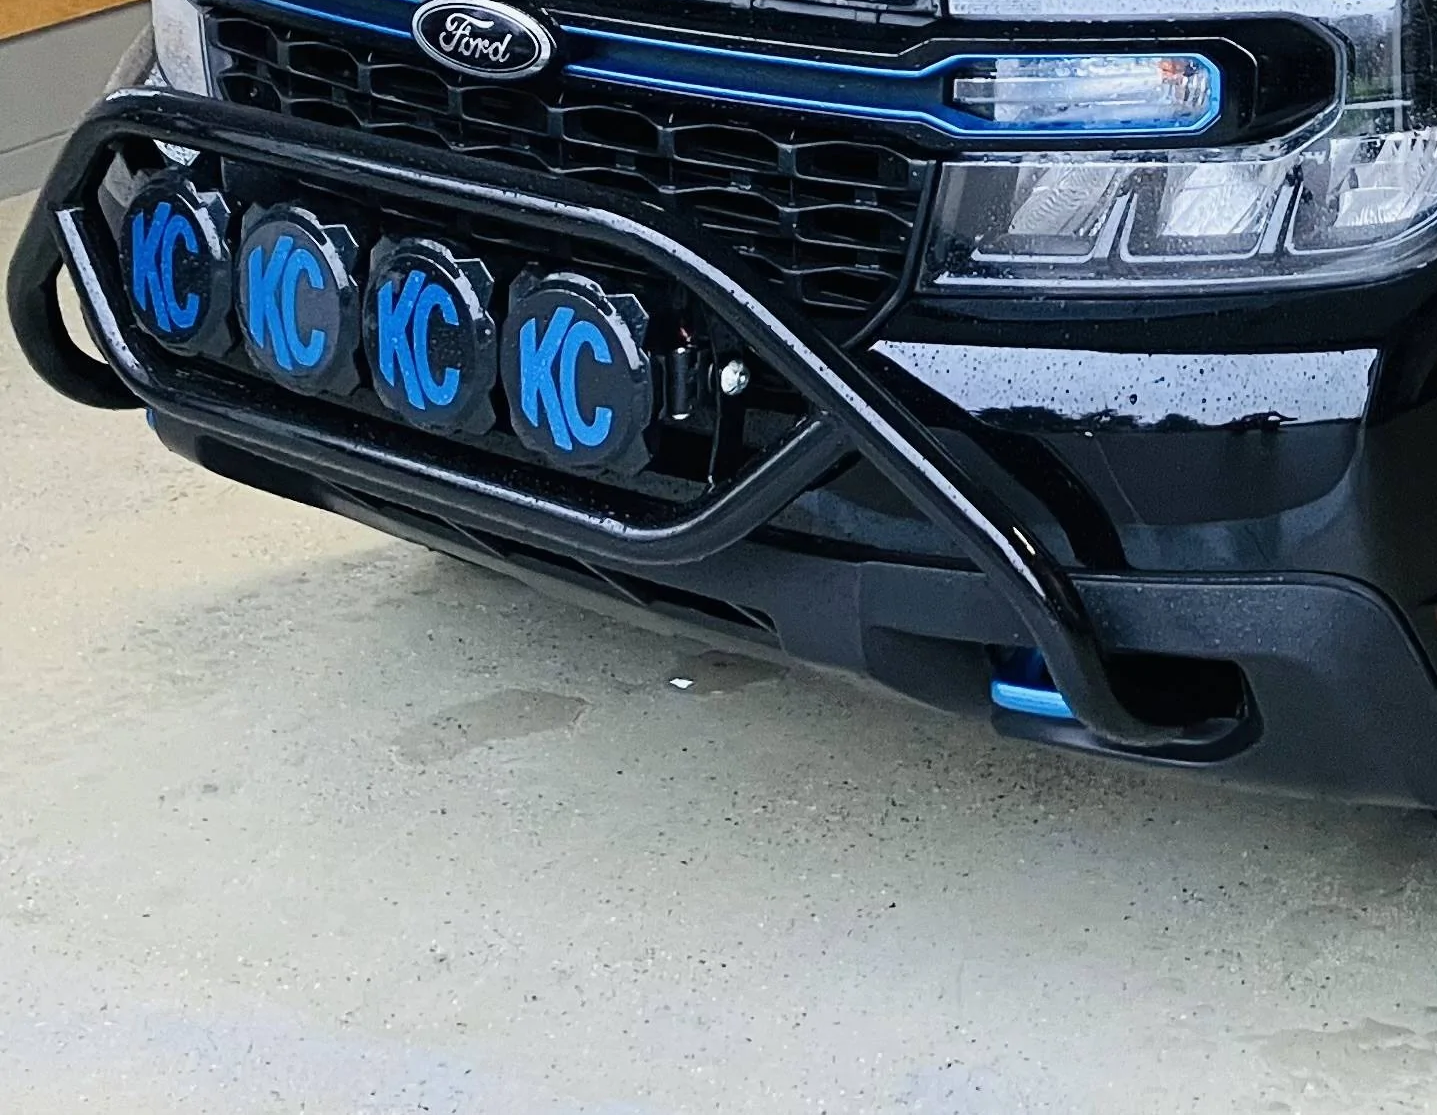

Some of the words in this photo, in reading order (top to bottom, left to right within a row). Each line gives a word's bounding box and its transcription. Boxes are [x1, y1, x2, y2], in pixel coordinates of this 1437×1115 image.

[438, 12, 513, 63] Ford
[132, 201, 199, 333] KC
[247, 234, 327, 372] KC
[377, 269, 460, 411] KC
[518, 306, 613, 451] KC
